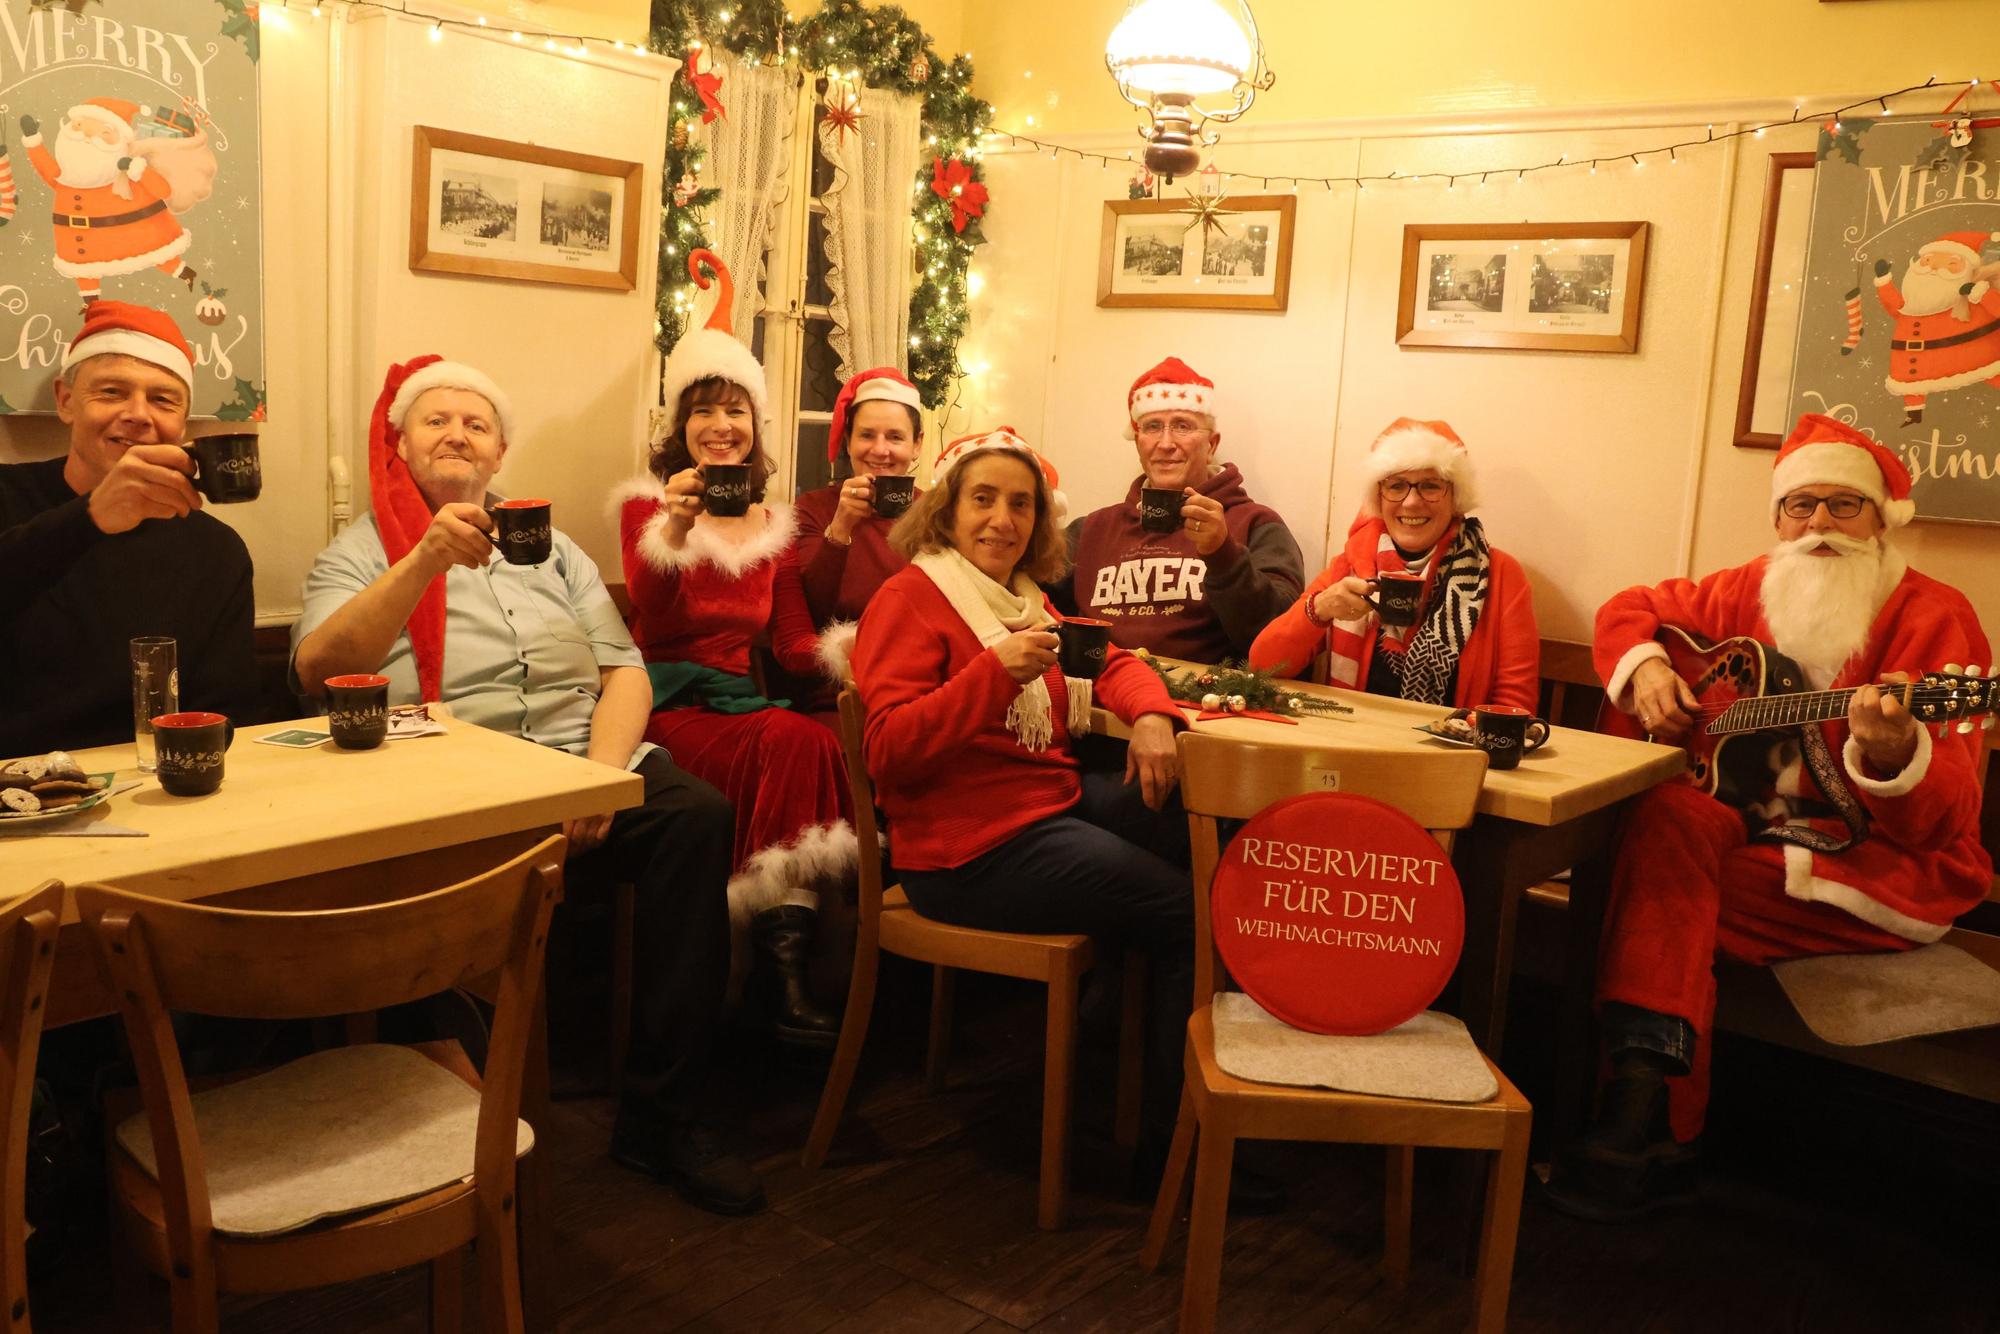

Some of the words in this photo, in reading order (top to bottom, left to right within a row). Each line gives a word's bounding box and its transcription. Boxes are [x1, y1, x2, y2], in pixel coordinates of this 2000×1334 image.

[0, 0, 218, 113] MERRY
[1844, 159, 2000, 243] MER
[1090, 558, 1207, 606] BAYER
[1129, 606, 1137, 616] &
[1242, 838, 1444, 886] RESERVIERT
[1263, 879, 1333, 915] FÜR
[1342, 890, 1416, 924] DEN
[1235, 917, 1441, 956] WEIHNACHTSMANN
